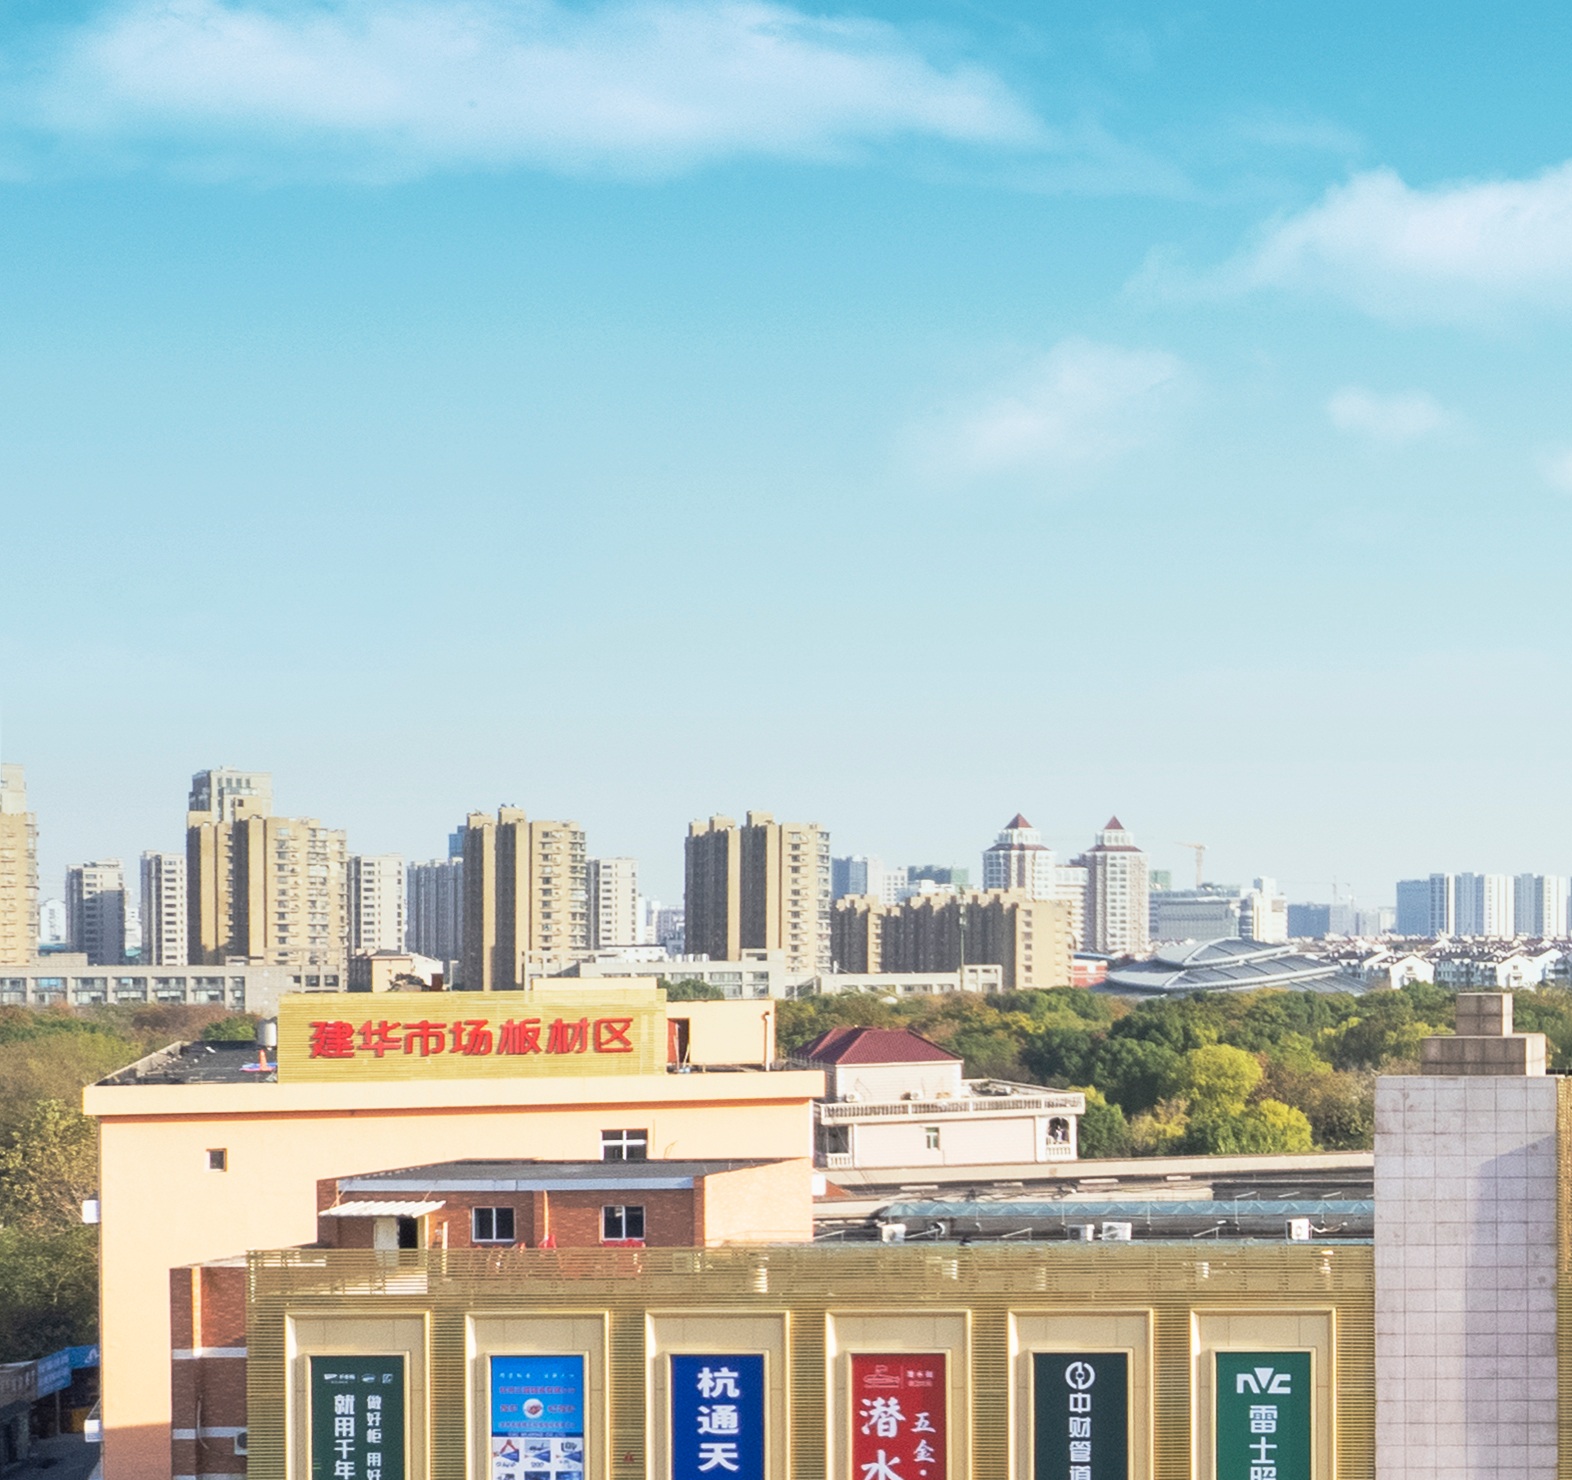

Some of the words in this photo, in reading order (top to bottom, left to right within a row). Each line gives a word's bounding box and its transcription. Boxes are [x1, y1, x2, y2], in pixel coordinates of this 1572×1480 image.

[309, 1017, 634, 1059] 建华市场板材区
